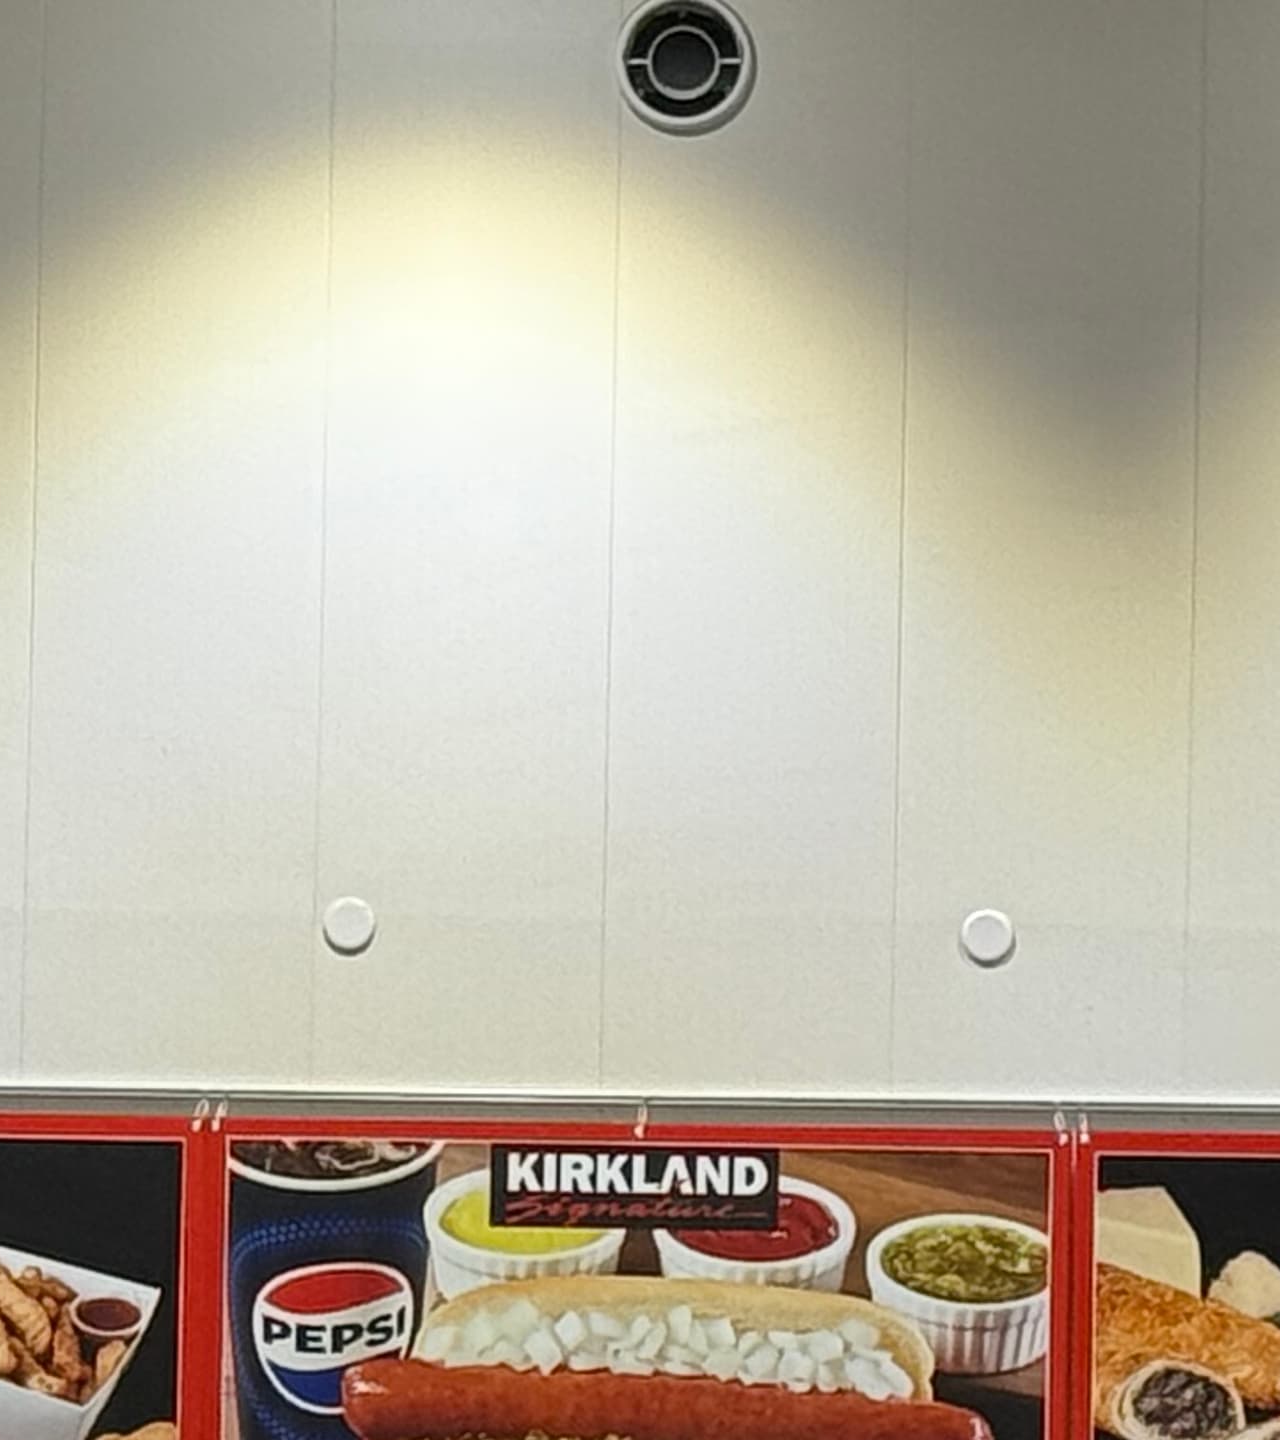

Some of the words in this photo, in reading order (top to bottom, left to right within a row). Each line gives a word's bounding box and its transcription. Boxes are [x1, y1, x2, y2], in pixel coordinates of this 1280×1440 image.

[505, 1152, 770, 1197] KIRKLAND
[504, 1194, 768, 1226] Signature
[262, 1305, 409, 1355] PEPSI
